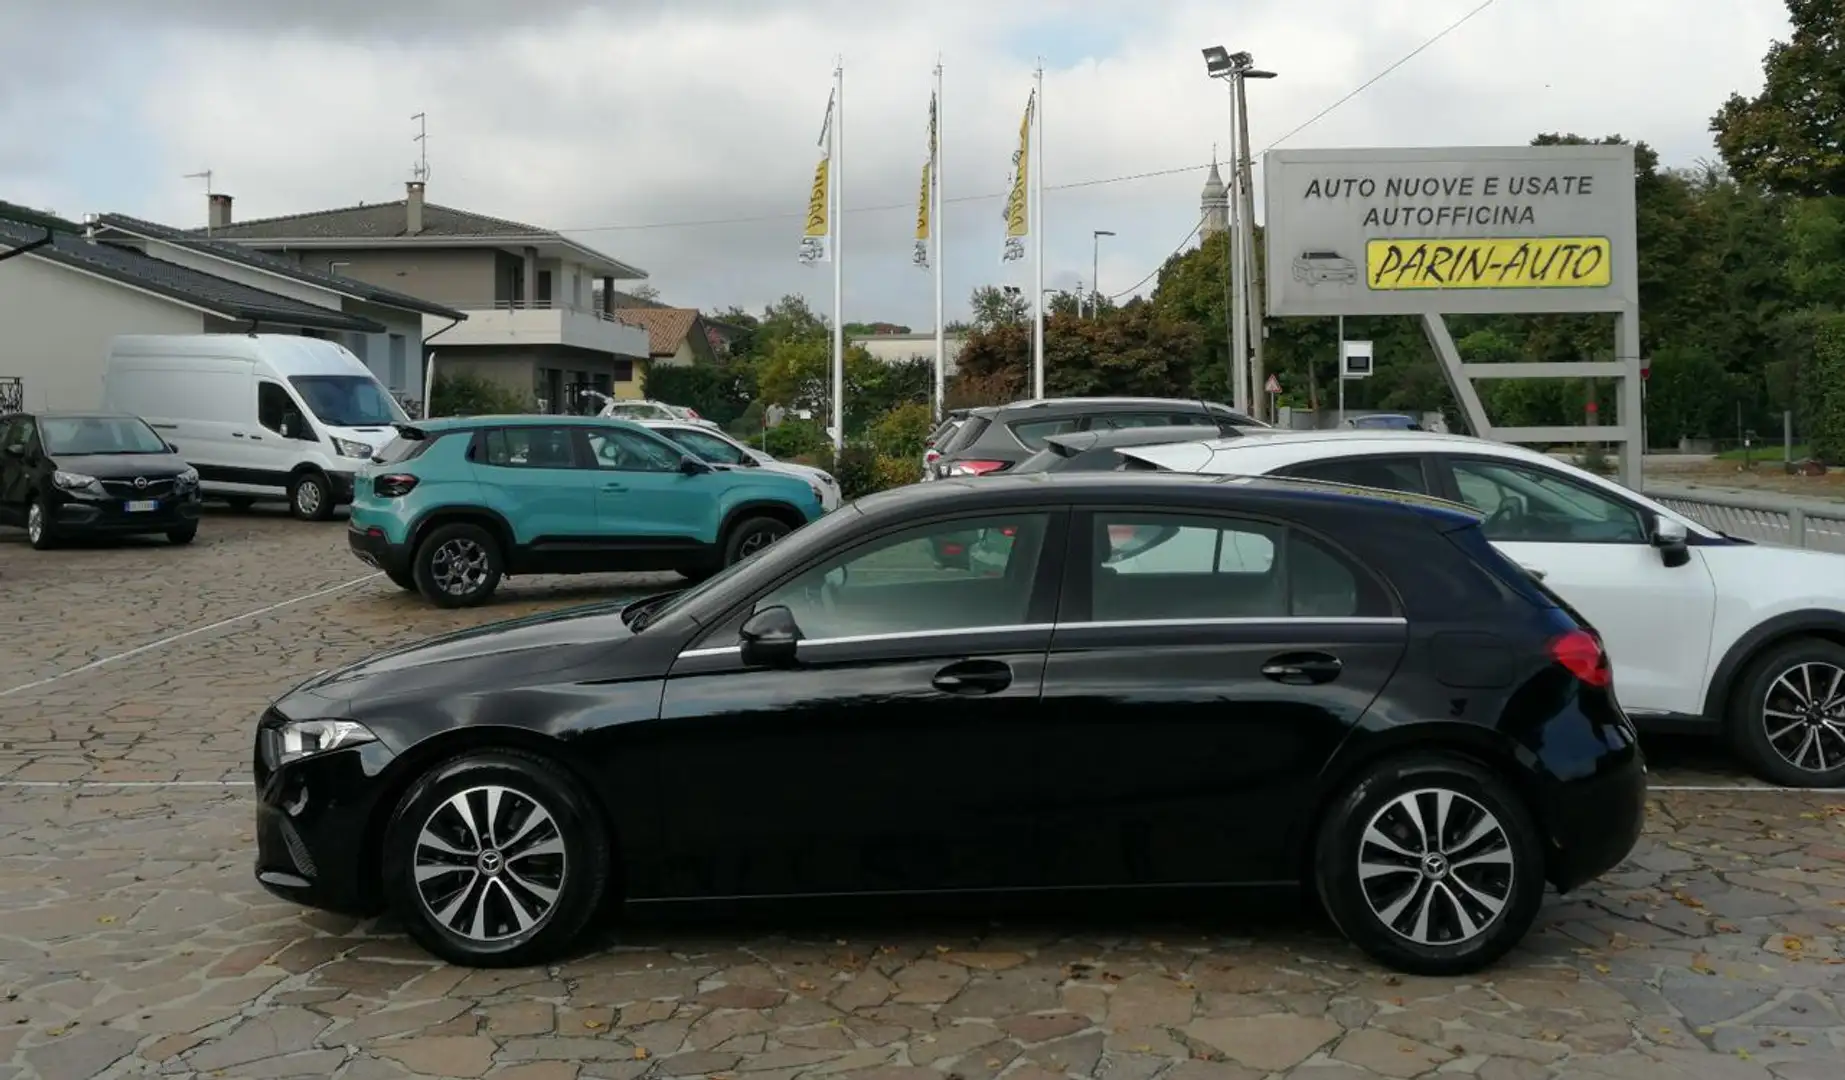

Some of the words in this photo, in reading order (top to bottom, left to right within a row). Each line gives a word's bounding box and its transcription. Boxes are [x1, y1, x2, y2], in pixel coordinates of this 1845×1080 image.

[1304, 178, 1375, 198] AUTO
[1385, 177, 1474, 197] NUOVE
[1483, 176, 1499, 196] E
[1508, 175, 1593, 196] USATE
[1363, 205, 1535, 227] AUTOFFICINA
[1375, 242, 1603, 284] PARIN-AUTO
